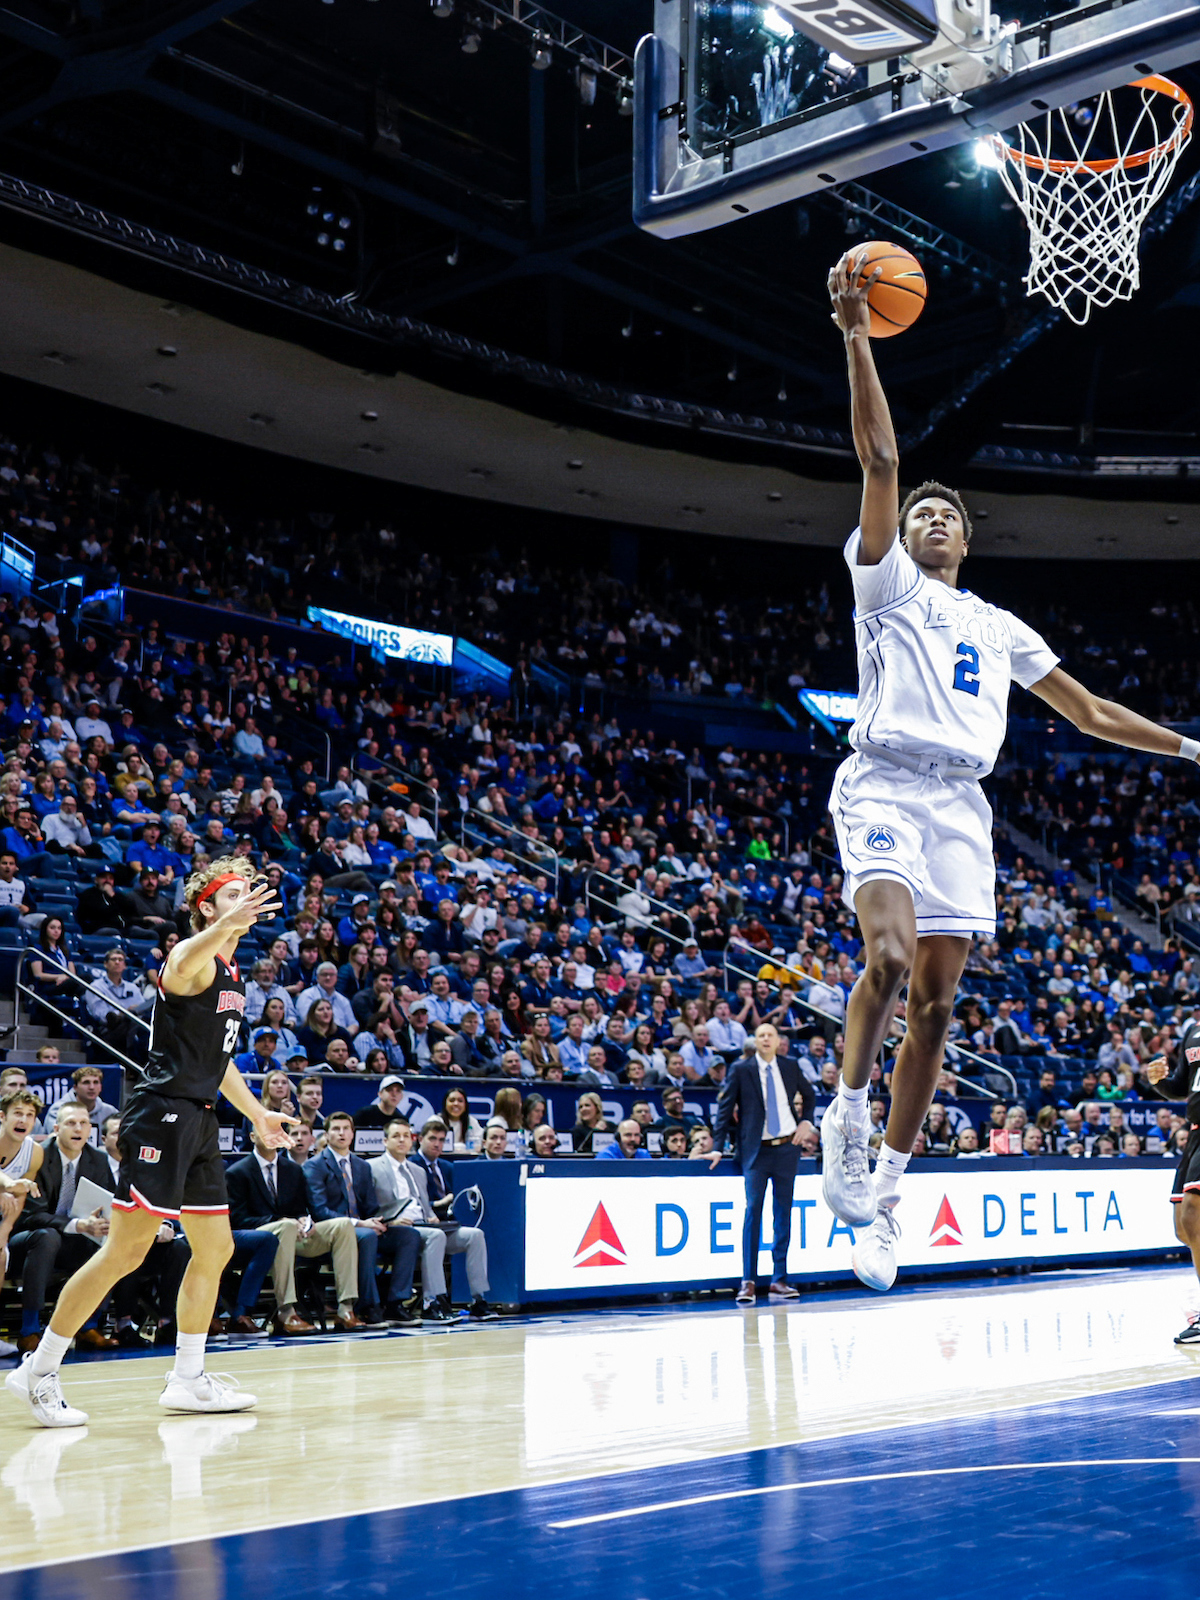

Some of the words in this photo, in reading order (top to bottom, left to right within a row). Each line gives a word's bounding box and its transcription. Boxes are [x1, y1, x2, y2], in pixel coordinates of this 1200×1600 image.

[952, 642, 980, 697] 2
[138, 1146, 162, 1164] DU
[983, 1190, 1124, 1238] DELTA
